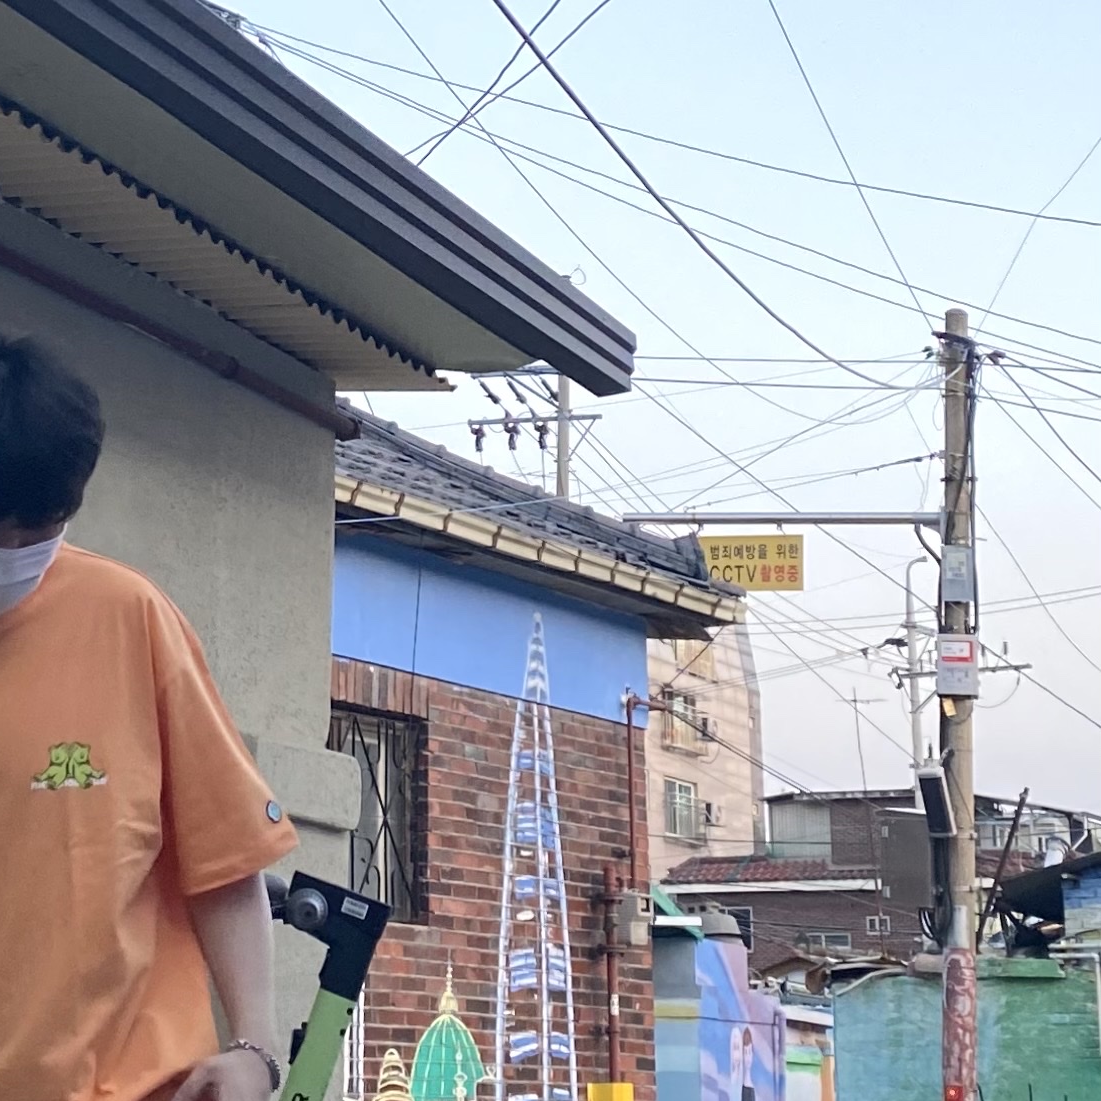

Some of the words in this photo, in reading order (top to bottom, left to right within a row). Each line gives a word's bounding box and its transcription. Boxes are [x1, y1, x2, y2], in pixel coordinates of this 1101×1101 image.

[710, 544, 767, 560] 범죄예방을
[776, 543, 799, 559] 위한
[709, 564, 757, 583] CCTV
[760, 564, 799, 583] 촬영중
